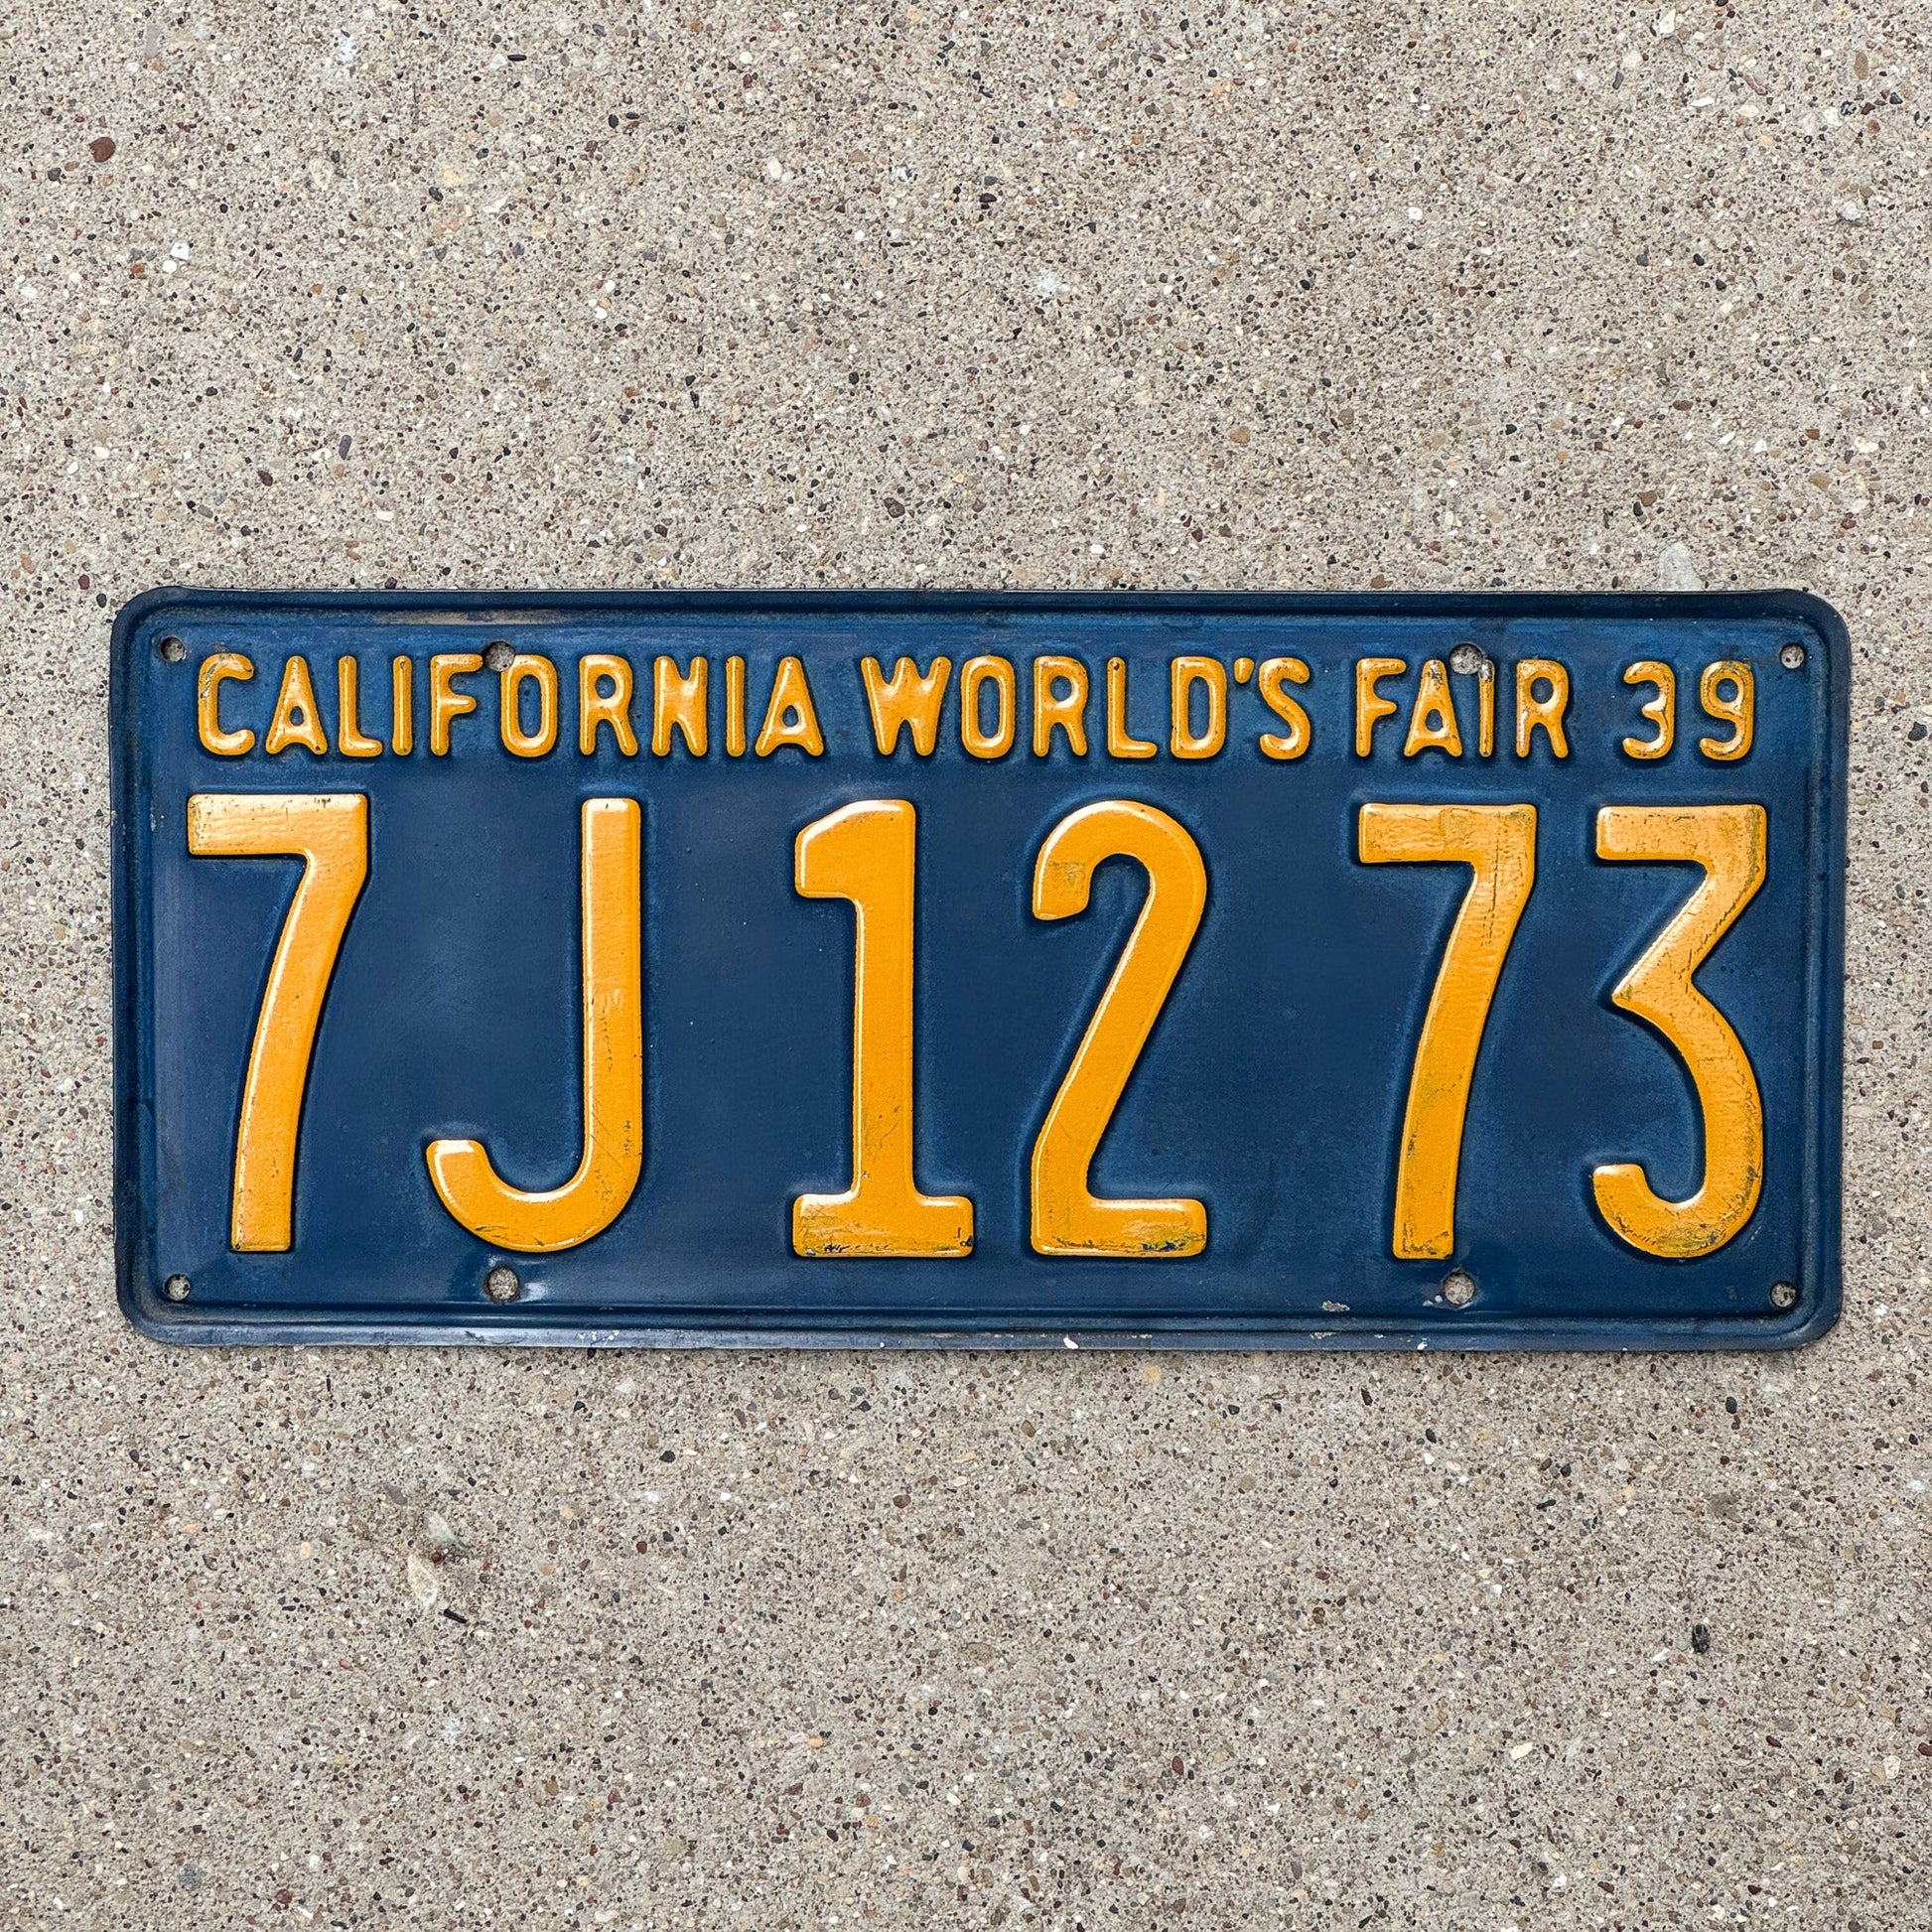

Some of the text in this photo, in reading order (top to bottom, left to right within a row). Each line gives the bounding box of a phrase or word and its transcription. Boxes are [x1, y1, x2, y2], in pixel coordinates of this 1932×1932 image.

[198, 652, 1755, 762] CALIFORNIA WORLD'S FAIR 39
